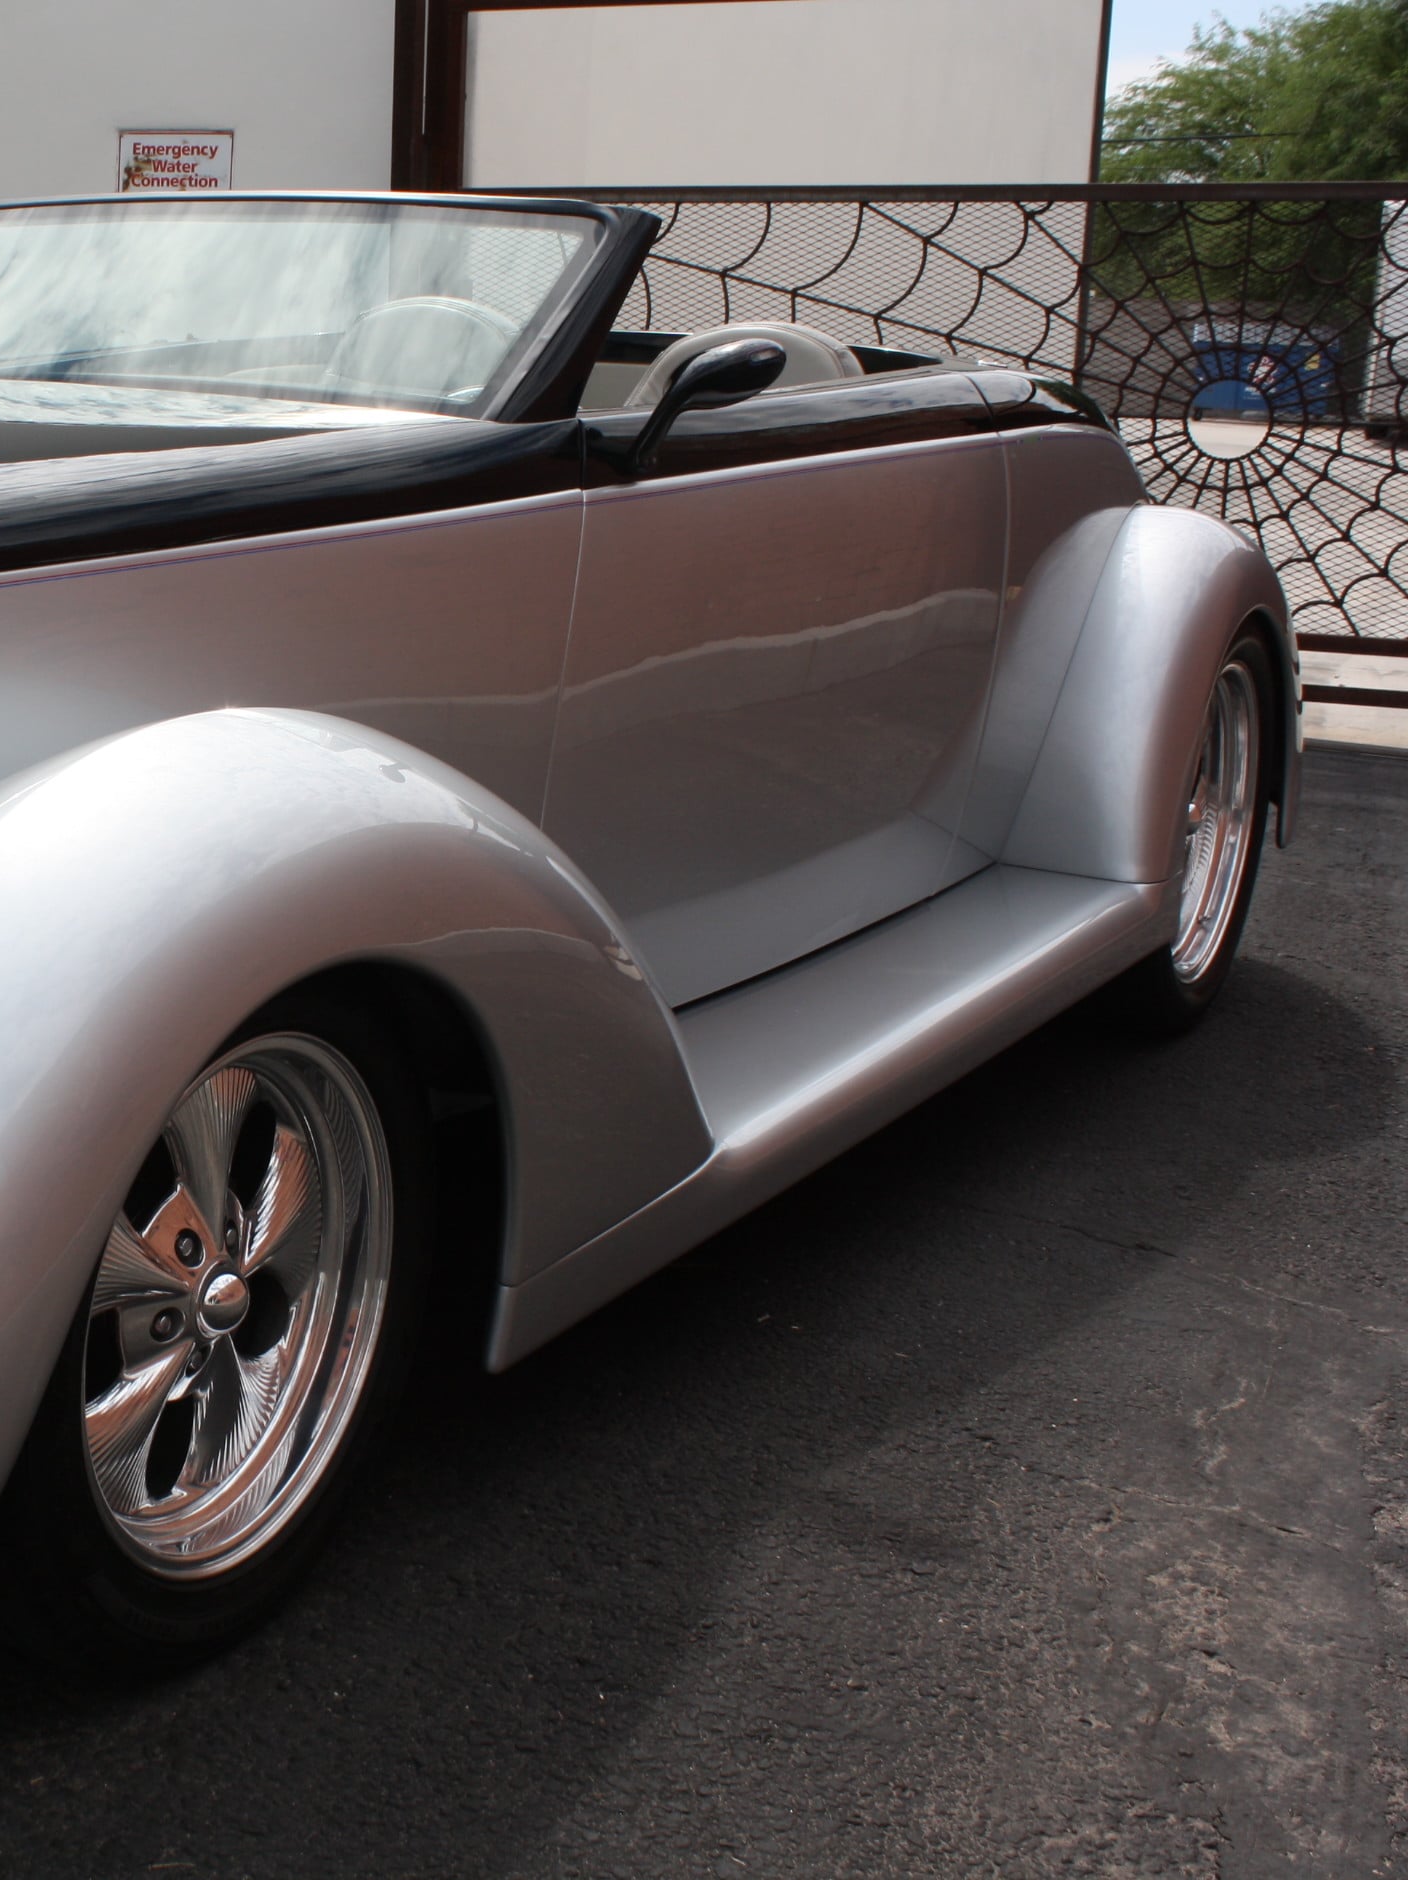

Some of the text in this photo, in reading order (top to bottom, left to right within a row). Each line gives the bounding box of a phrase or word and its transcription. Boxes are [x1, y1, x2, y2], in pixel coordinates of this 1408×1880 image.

[132, 142, 218, 159] Emergency
[152, 160, 198, 173] Water
[131, 173, 218, 188] Connection
